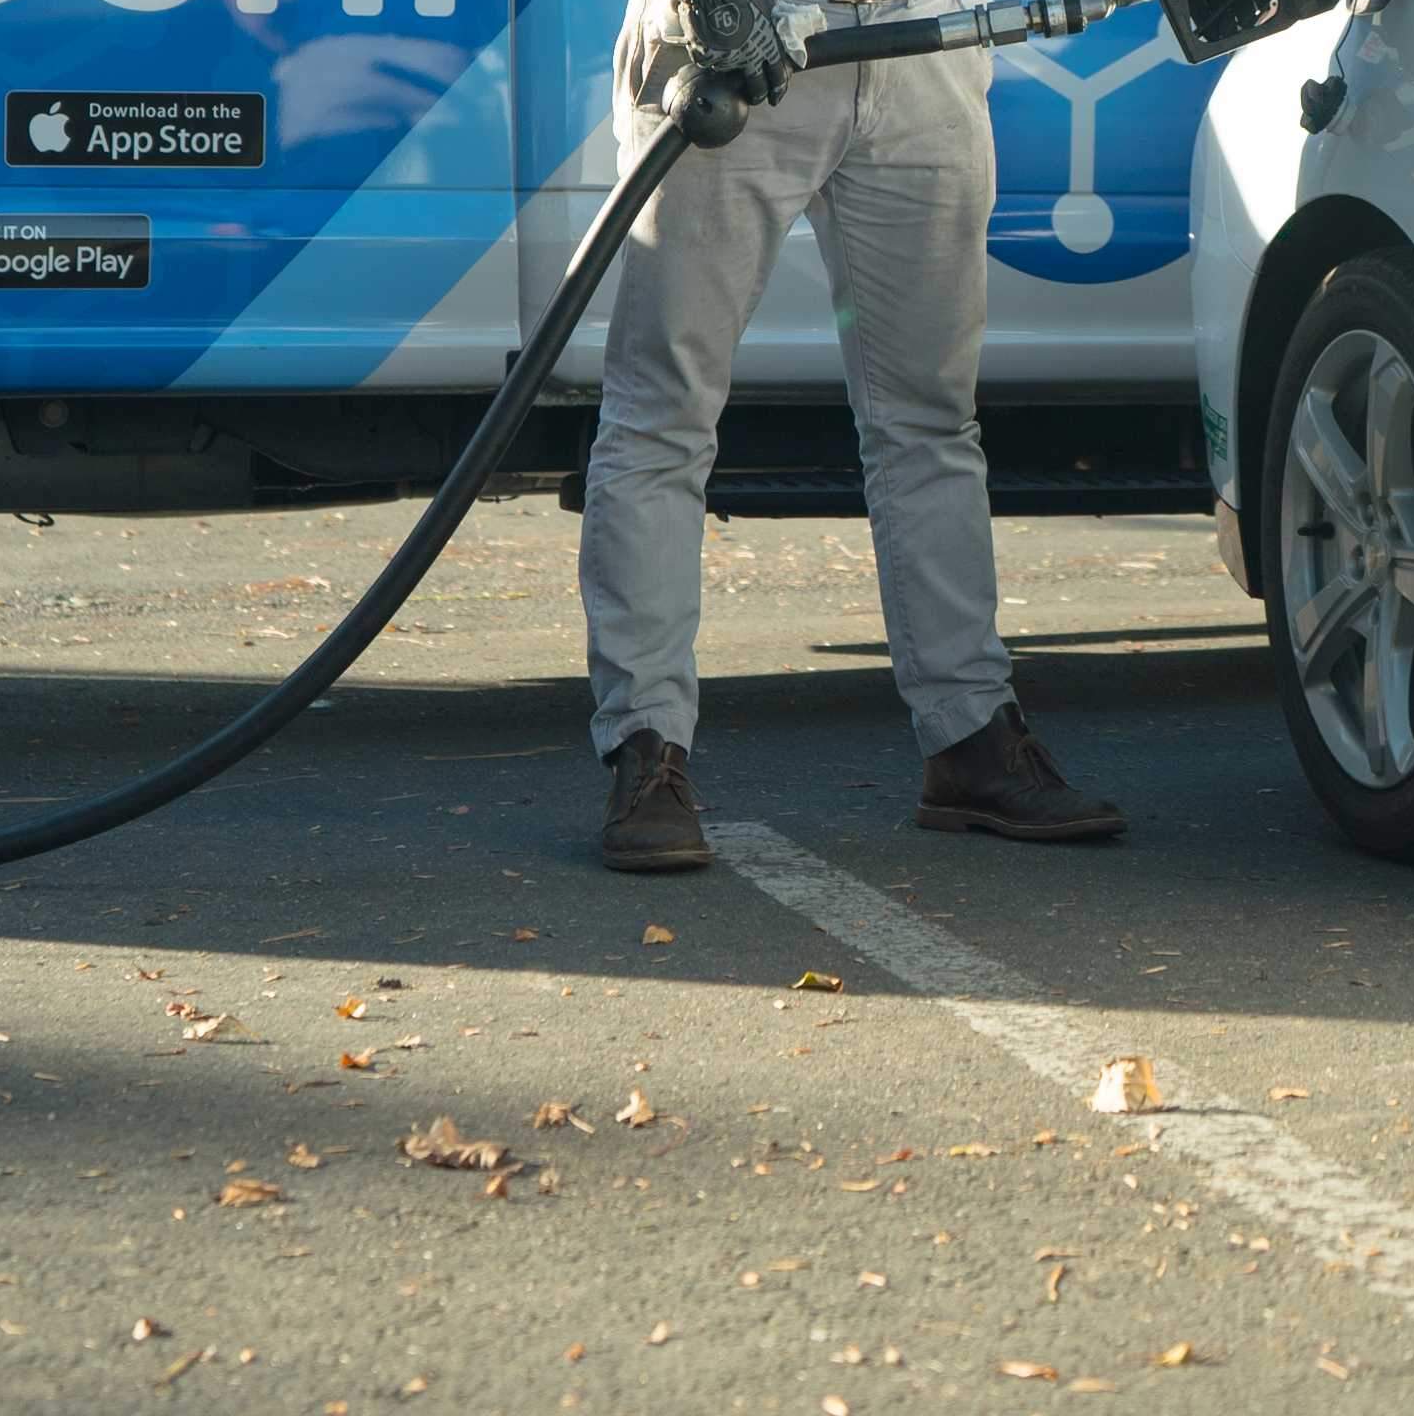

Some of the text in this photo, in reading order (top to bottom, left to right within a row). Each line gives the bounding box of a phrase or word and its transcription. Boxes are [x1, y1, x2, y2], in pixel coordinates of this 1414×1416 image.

[89, 102, 241, 119] Download on the
[87, 125, 243, 160] App Store
[3, 226, 18, 240] IT
[20, 226, 46, 240] ON
[77, 247, 134, 280] Play
